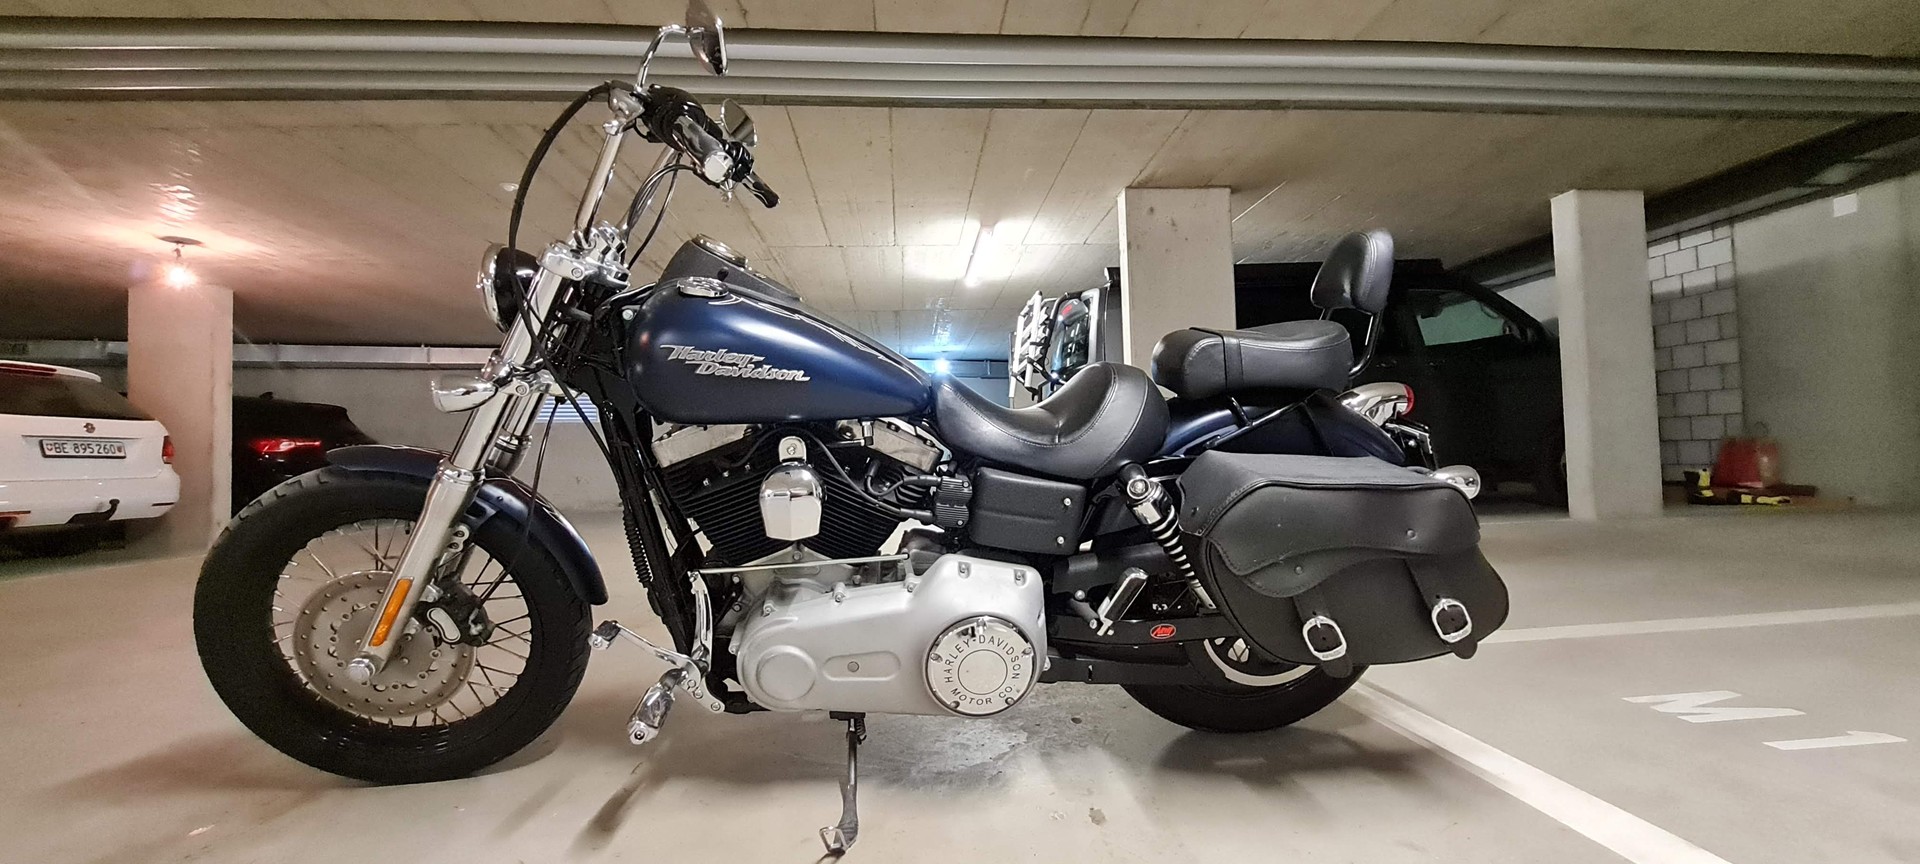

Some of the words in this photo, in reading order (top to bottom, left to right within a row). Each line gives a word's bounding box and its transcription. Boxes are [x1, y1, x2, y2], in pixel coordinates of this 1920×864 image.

[685, 360, 811, 382] Davidson
[53, 442, 69, 454] BE
[951, 688, 993, 706] MOTOR
